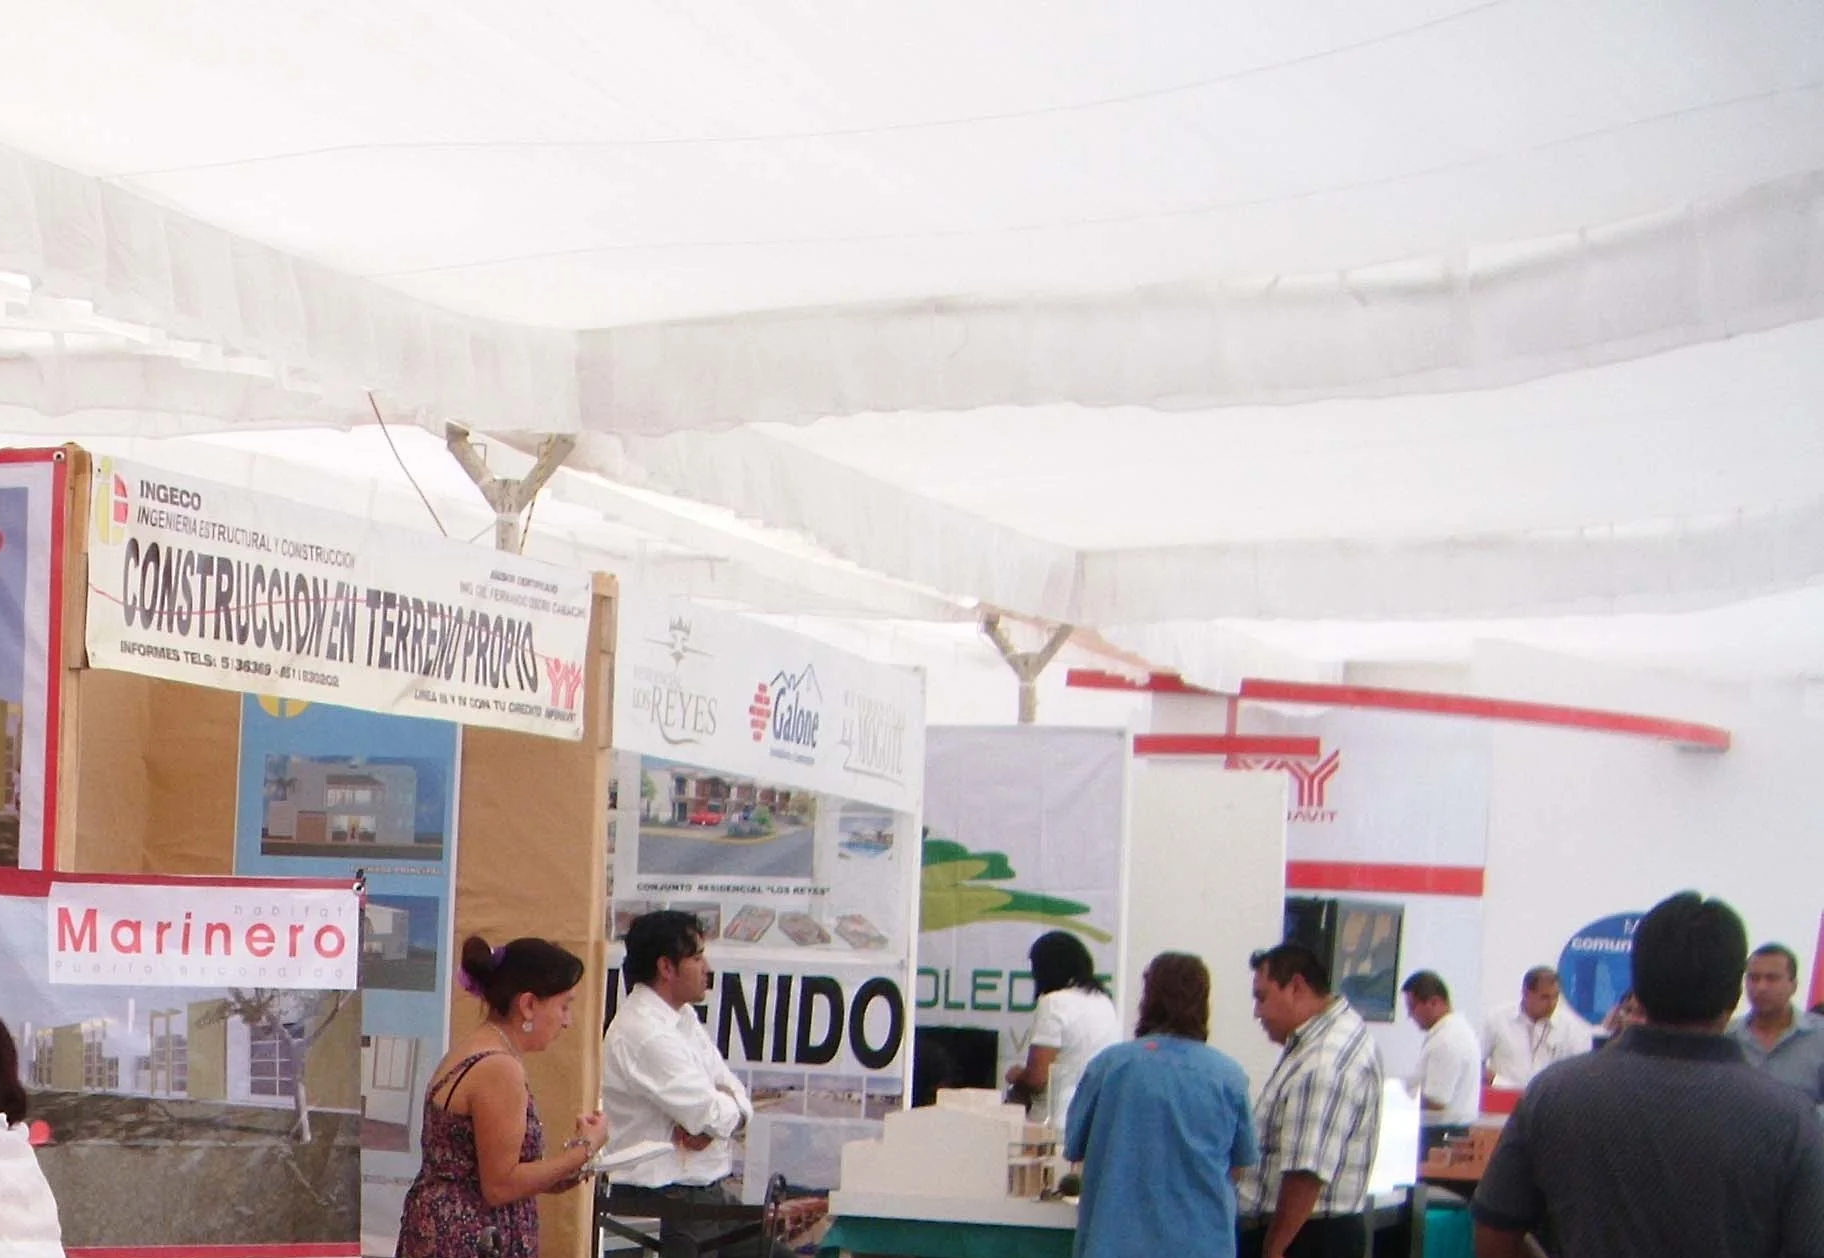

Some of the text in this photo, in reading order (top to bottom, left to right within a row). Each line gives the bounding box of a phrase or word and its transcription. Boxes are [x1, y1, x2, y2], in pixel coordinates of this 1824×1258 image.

[139, 479, 202, 512] INGECO
[137, 505, 198, 536] INGENIERIA
[198, 519, 272, 553] ESTRUCTURAL
[281, 538, 356, 570] CONSTRUCCION
[123, 537, 539, 694] CONSTRUCCION EN TERRENO PROPIO
[120, 640, 180, 662] INFORMES
[183, 650, 217, 668] TELS:
[494, 700, 506, 712] TU
[650, 685, 719, 737] REYES
[1287, 810, 1339, 822] AVIT
[636, 883, 692, 893] CONJUNTO
[697, 884, 762, 895] RESIDENCIAL
[56, 907, 346, 958] Marinero
[917, 967, 1113, 1012] OLED
